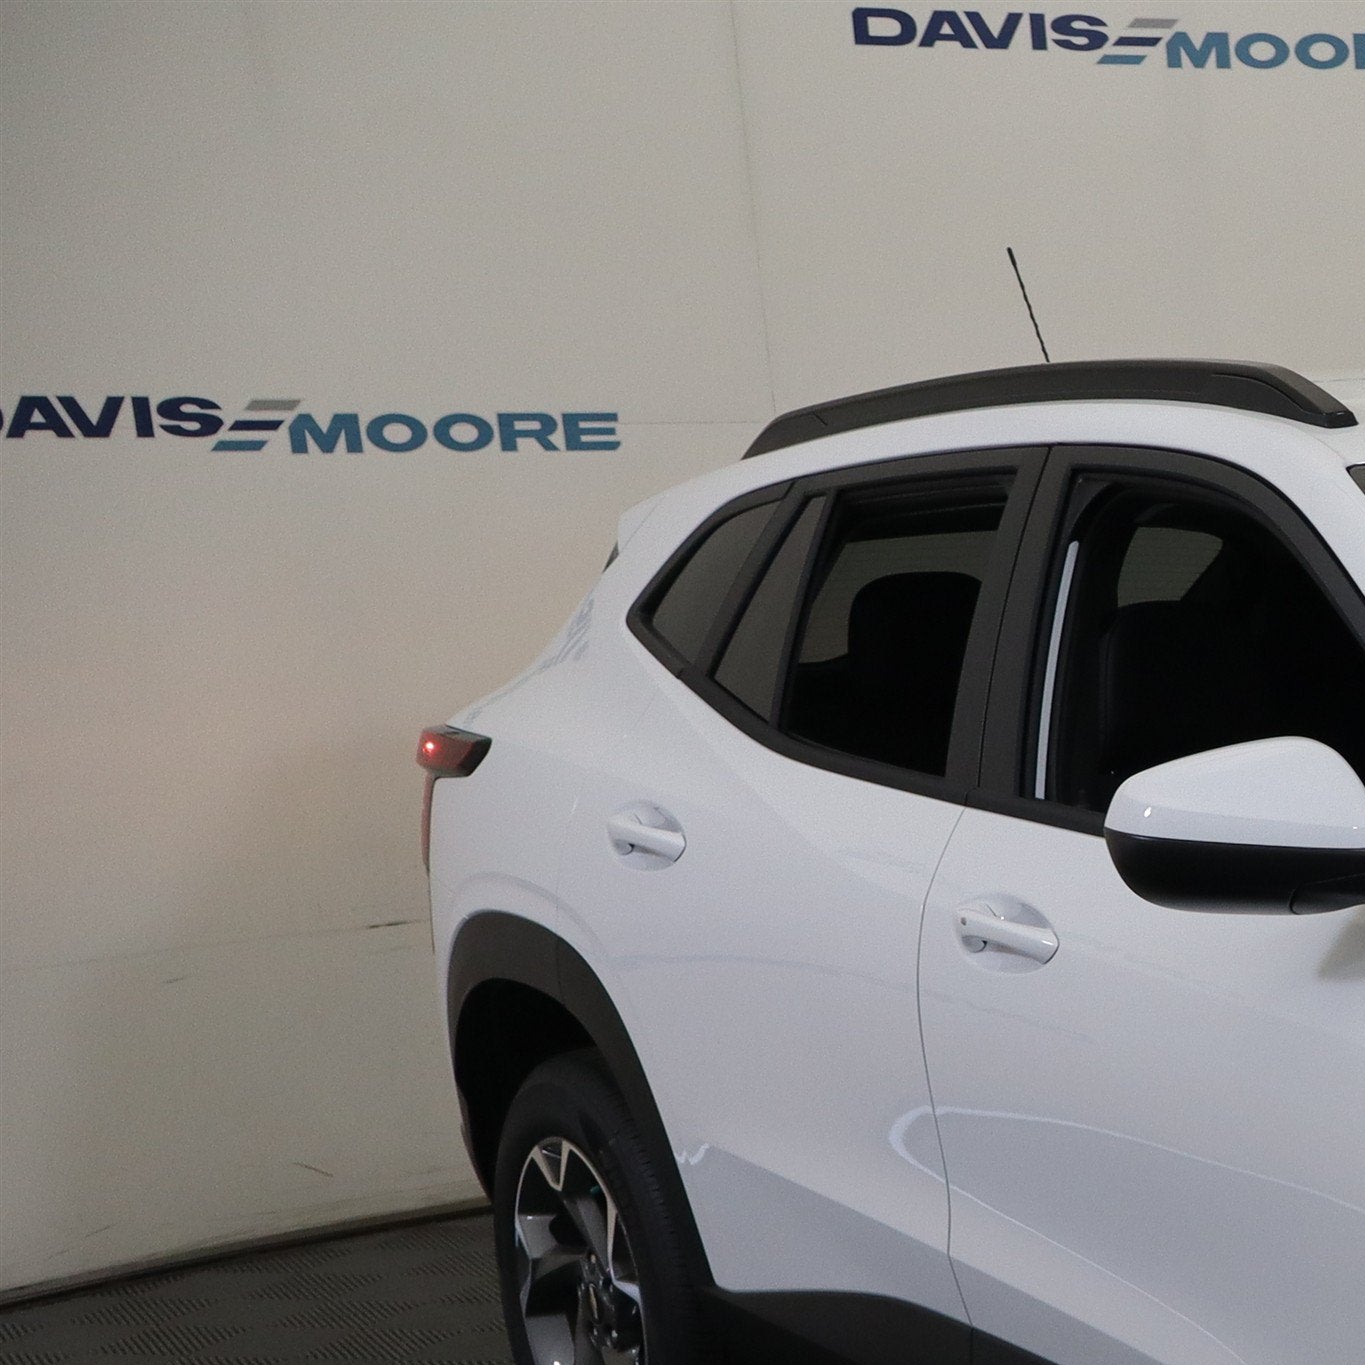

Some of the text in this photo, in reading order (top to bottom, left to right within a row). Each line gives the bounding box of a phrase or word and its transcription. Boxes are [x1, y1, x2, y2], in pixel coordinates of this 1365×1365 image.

[852, 6, 1109, 52] DAVIS
[0, 395, 622, 455] AVIS MOORE
